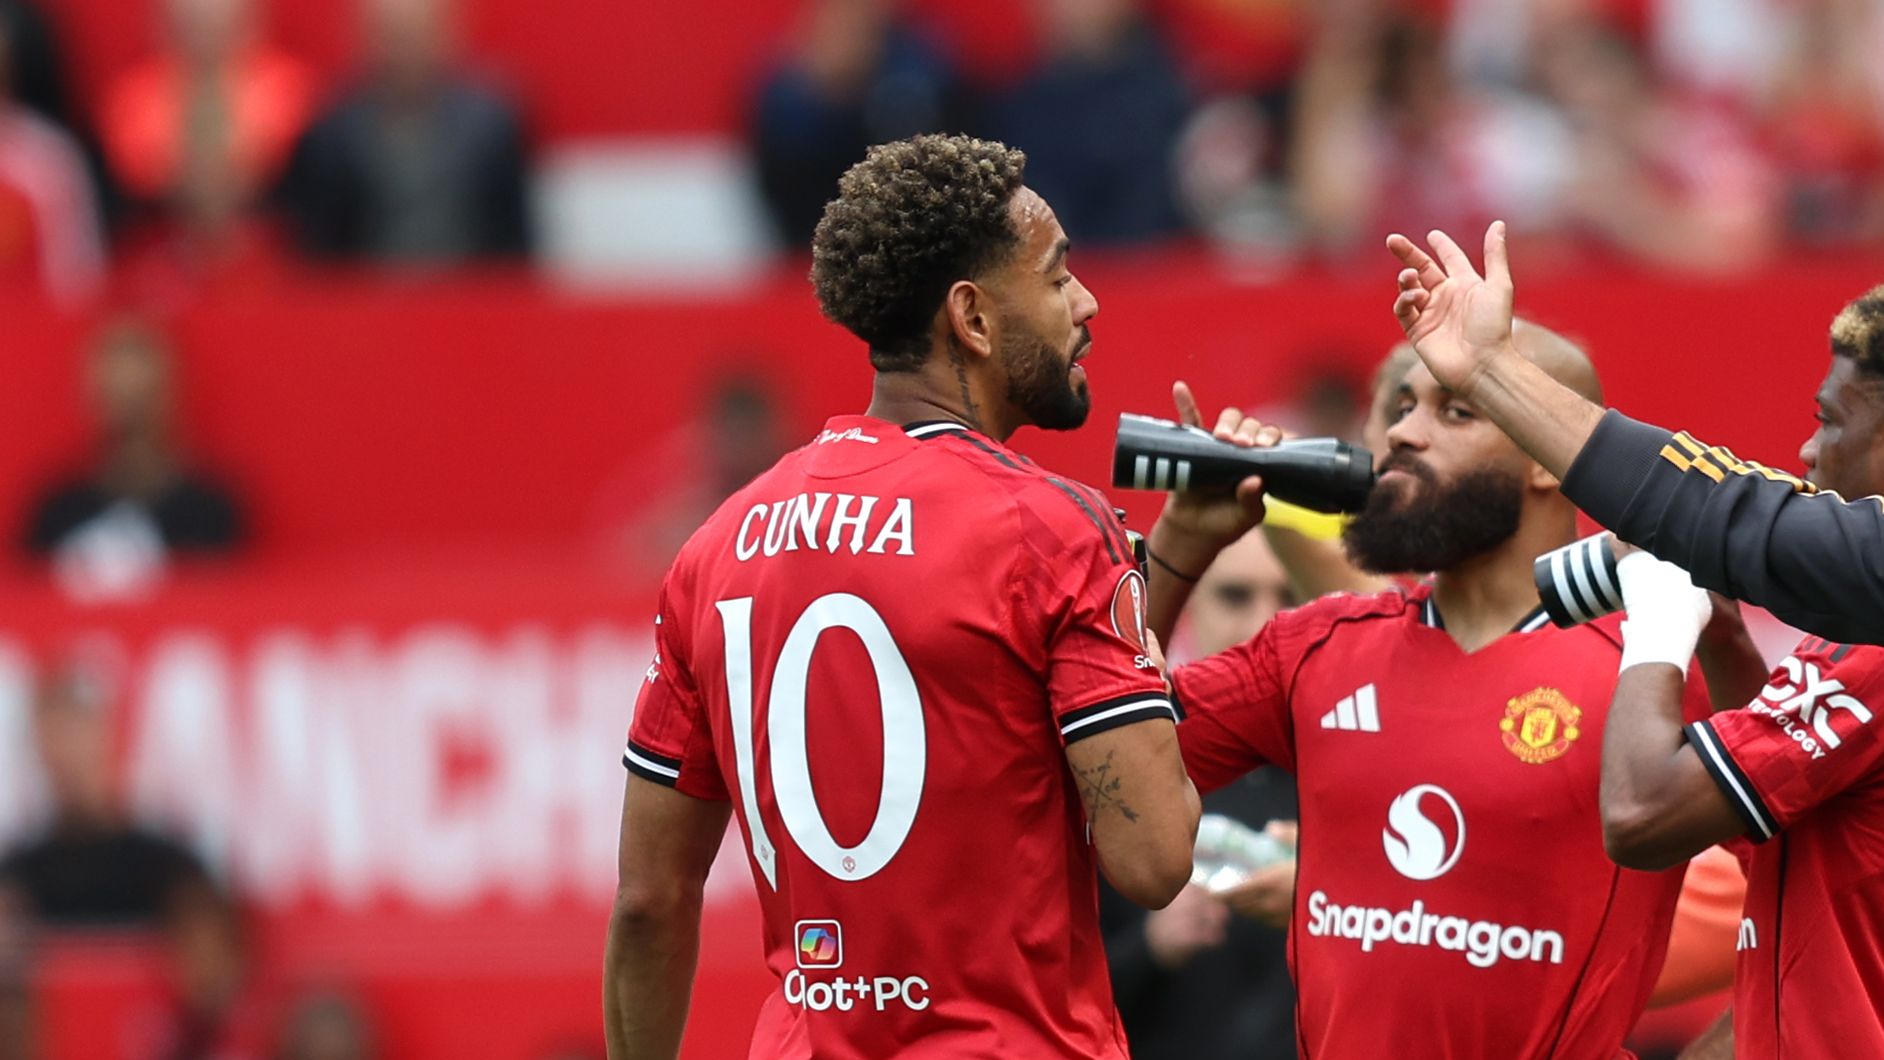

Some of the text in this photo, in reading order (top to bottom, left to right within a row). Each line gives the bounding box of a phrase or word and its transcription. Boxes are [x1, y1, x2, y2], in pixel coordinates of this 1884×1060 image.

[735, 492, 915, 562] CUNHA
[714, 592, 927, 893] 10
[1761, 656, 1873, 749] DXC
[1307, 890, 1564, 967] Snapdragon
